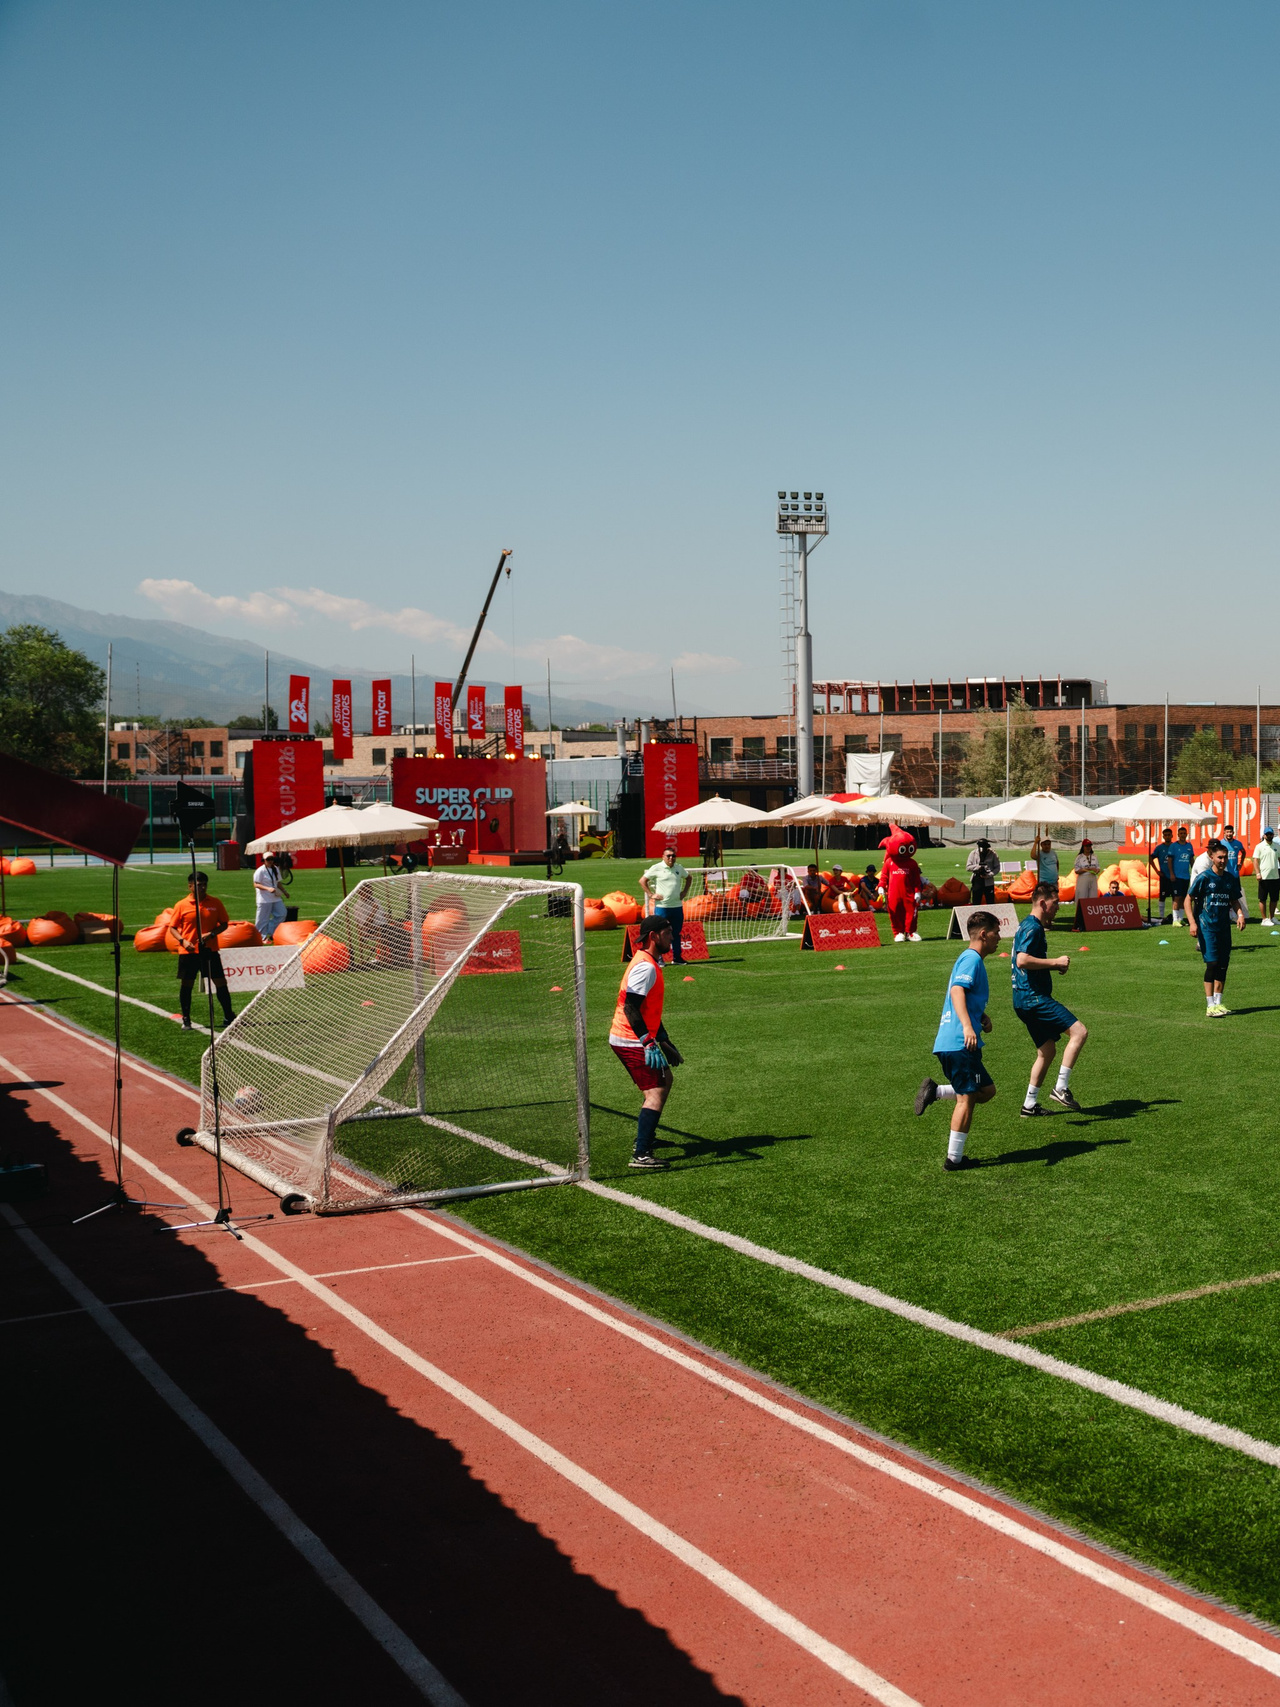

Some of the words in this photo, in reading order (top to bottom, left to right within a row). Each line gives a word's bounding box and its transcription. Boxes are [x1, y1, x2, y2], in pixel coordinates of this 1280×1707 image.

[341, 694, 350, 738] MOTORS
[443, 697, 452, 739] MOTORS
[514, 709, 522, 750] MOTORS
[278, 746, 296, 783] 2026
[663, 748, 677, 781] 2026
[280, 785, 297, 816] CUP
[415, 787, 471, 804] SUPER
[473, 787, 514, 804] CUP
[664, 782, 678, 810] CUP
[437, 804, 486, 821] 2026
[1087, 904, 1115, 915] SUPER
[1116, 903, 1135, 914] CUP
[1102, 914, 1126, 926] 2026
